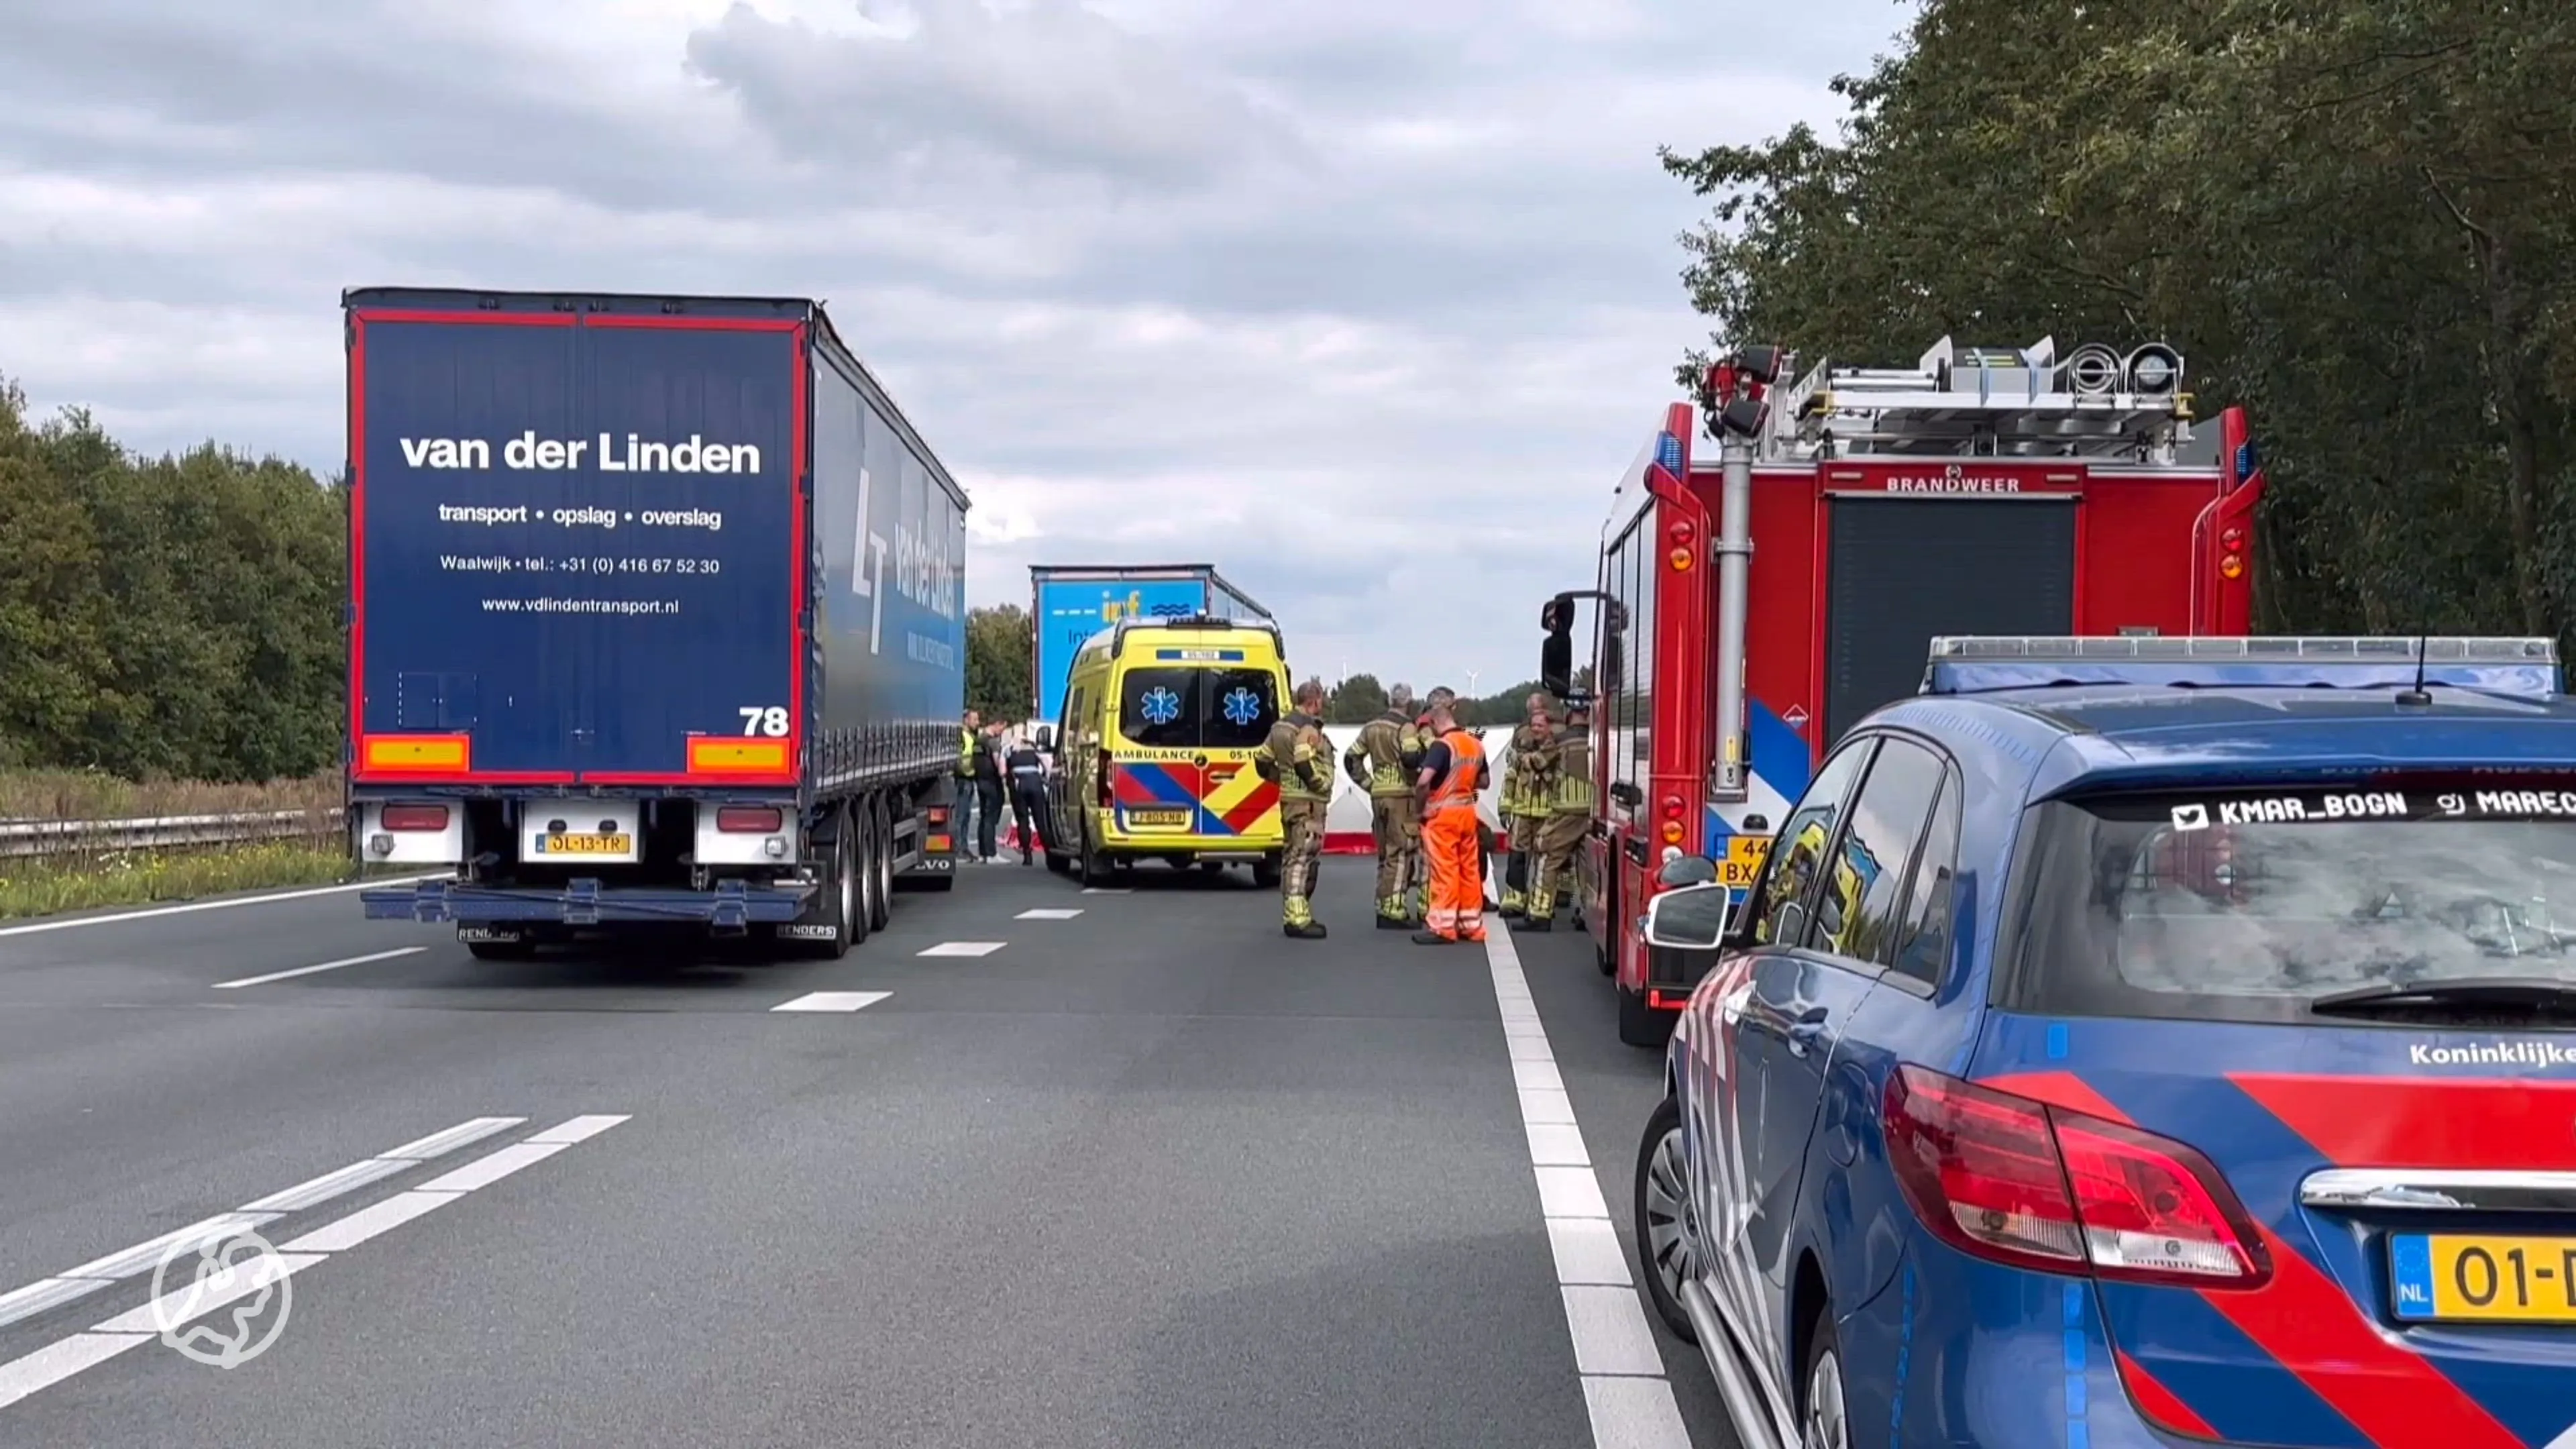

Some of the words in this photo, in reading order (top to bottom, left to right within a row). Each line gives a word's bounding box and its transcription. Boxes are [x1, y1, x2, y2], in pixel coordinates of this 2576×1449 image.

[400, 437, 489, 468] van
[504, 430, 587, 469] der
[598, 432, 761, 473] Linden
[1886, 476, 2020, 492] BRANDWEER
[439, 503, 527, 526] transport
[552, 505, 616, 528] opslag
[641, 508, 722, 531] overslag
[440, 555, 512, 574] Waalwijk
[525, 557, 554, 572] tel.:
[559, 557, 586, 572] +31
[592, 557, 613, 575] (0)
[619, 558, 647, 573] 416
[652, 559, 672, 573] 67
[676, 559, 696, 574] 52
[700, 559, 720, 574] 30
[482, 597, 679, 616] www.vdlindentransport.nl
[739, 706, 789, 737] 78
[1114, 749, 1195, 760] AMBULANCE
[2219, 792, 2408, 825] KMAR_BOGN
[2455, 1246, 2576, 1307] 01-
[2400, 1283, 2429, 1303] NL
